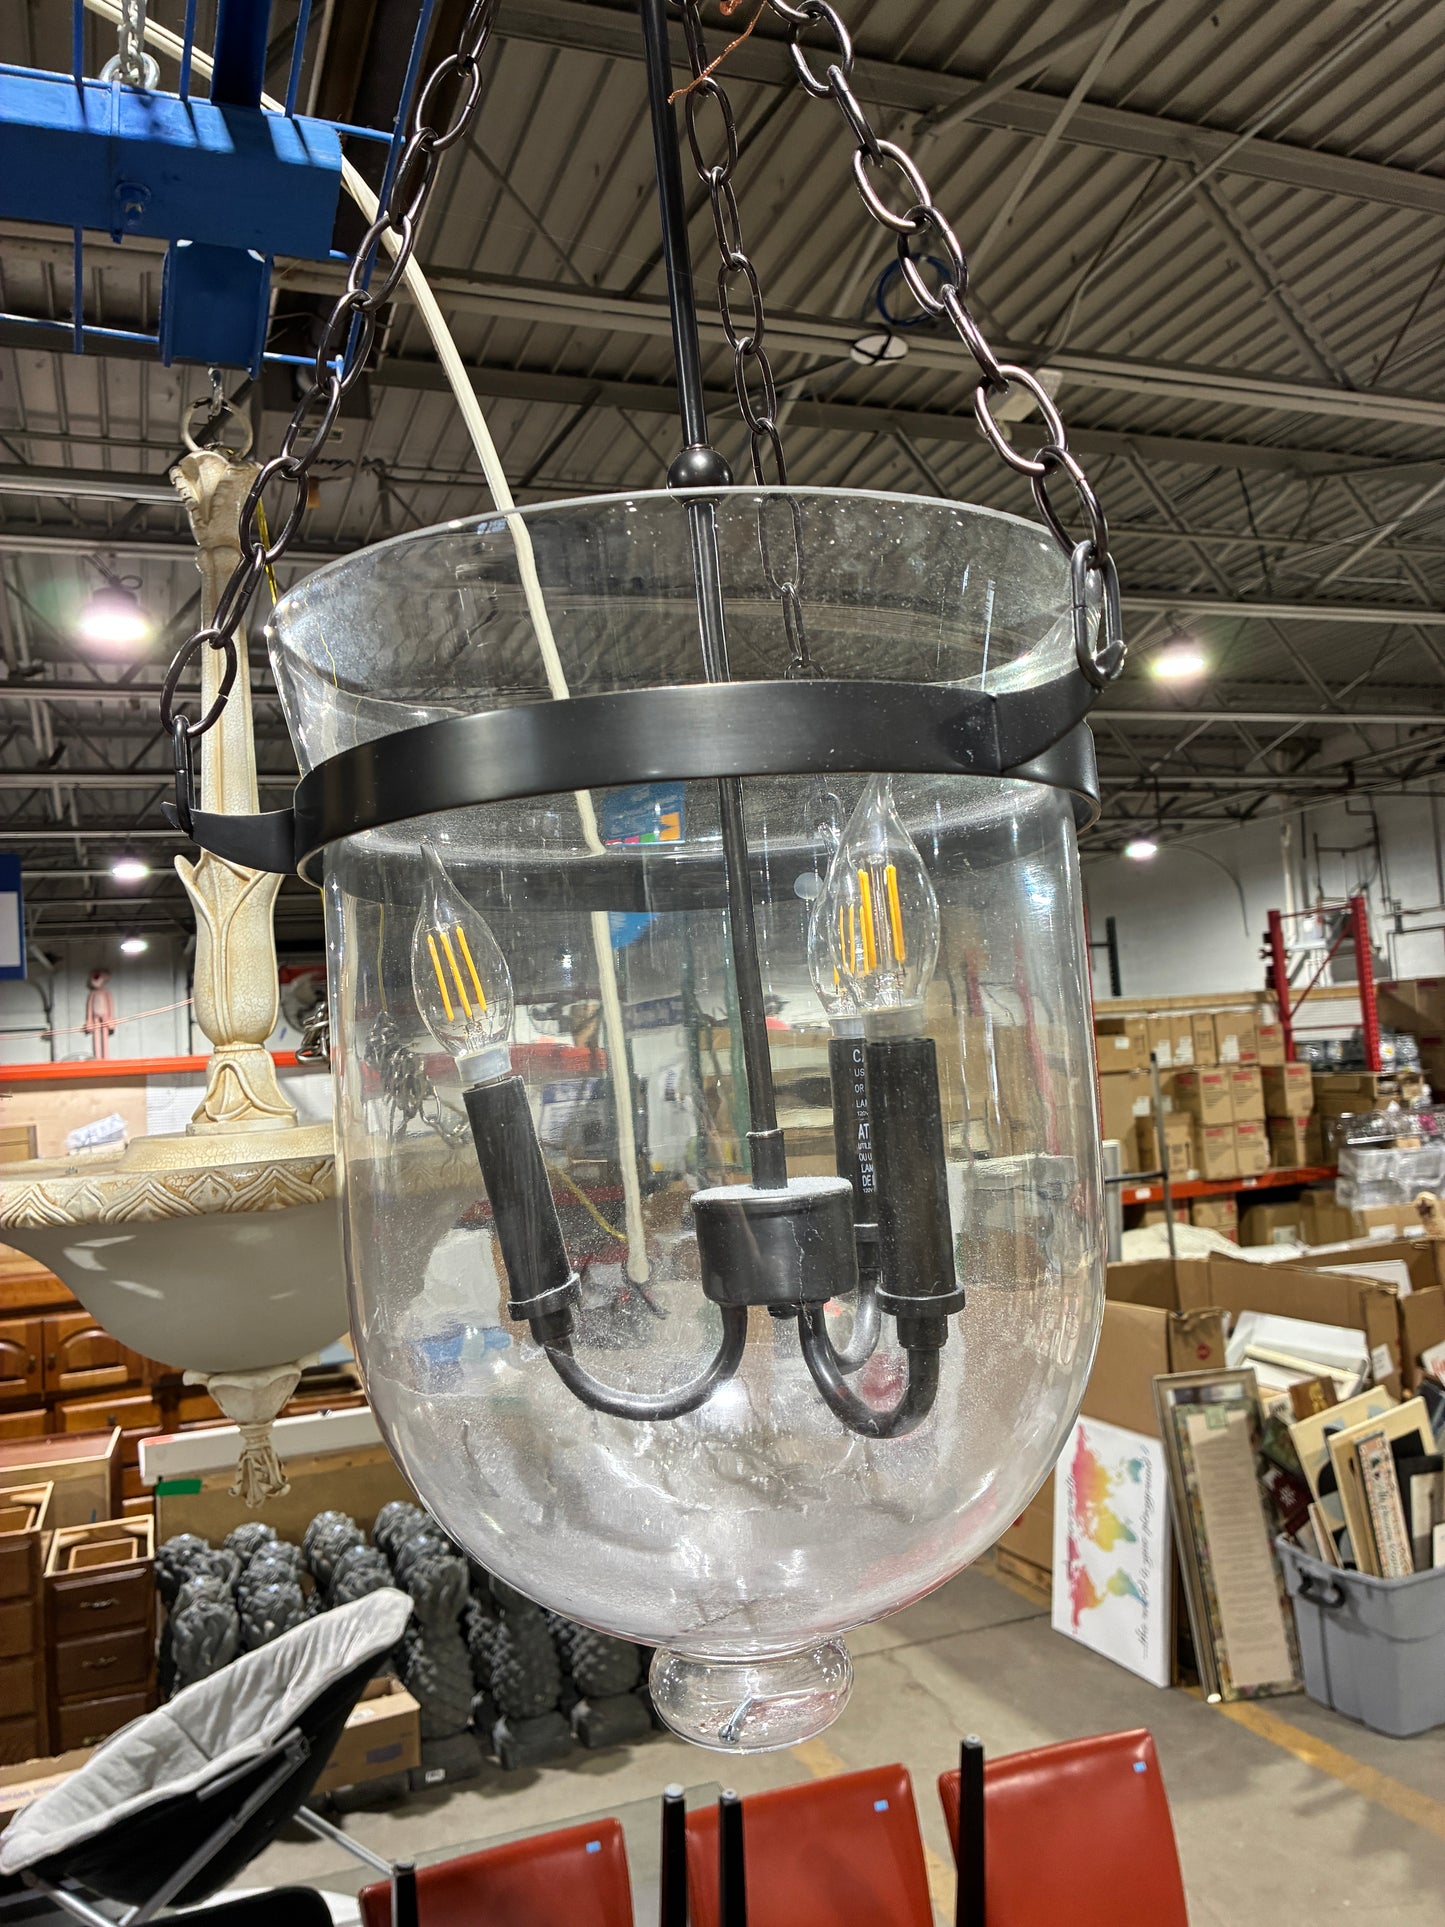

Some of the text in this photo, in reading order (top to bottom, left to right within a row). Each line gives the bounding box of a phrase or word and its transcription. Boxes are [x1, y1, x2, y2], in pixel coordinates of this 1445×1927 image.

[854, 1084, 865, 1094] OR
[859, 1152, 868, 1162] OU
[862, 1174, 872, 1187] DE
